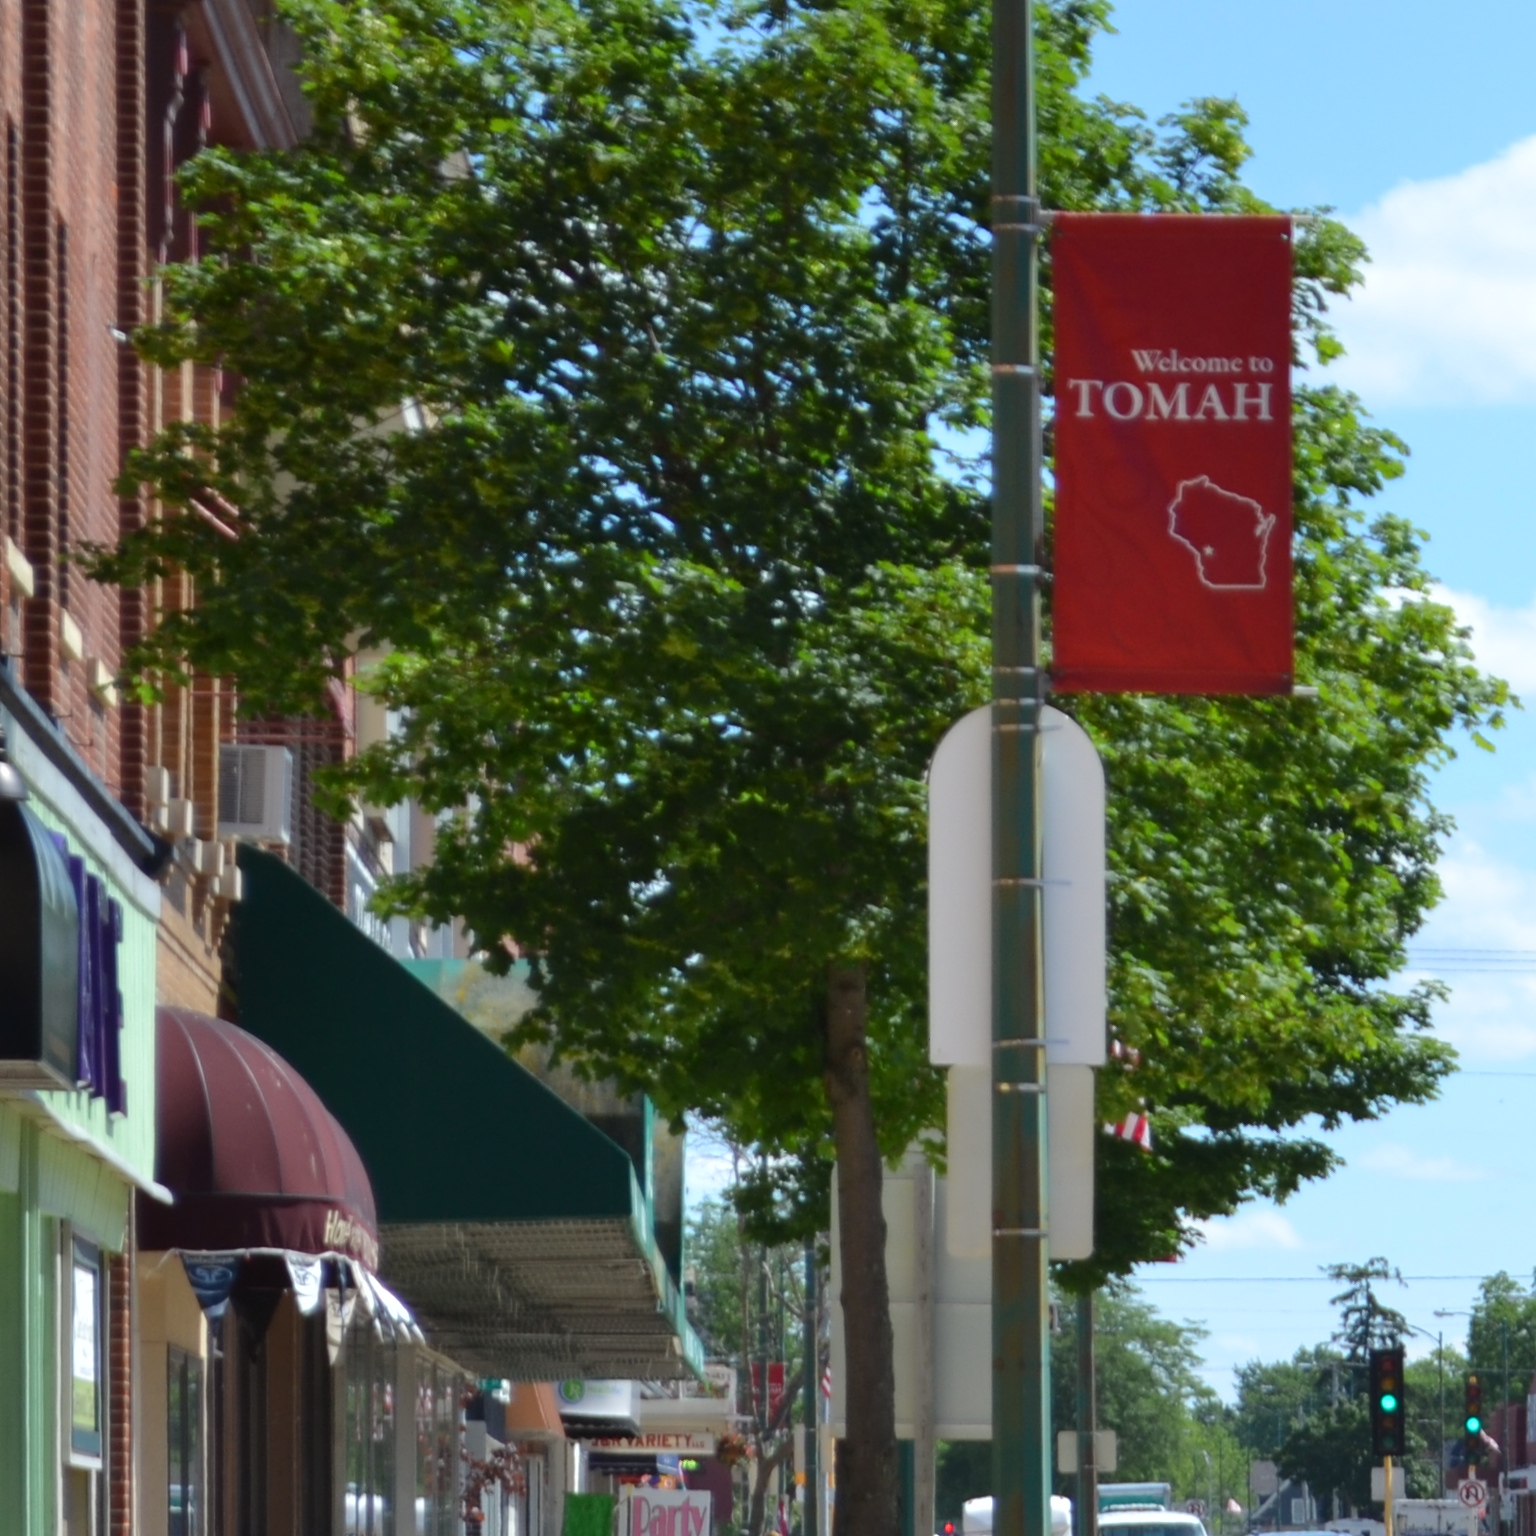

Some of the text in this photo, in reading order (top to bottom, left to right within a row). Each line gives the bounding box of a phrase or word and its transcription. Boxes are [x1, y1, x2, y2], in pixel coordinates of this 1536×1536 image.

[1131, 349, 1274, 373] Welcome to
[1068, 379, 1274, 421] TOMAH
[628, 1434, 692, 1448] VARIETY
